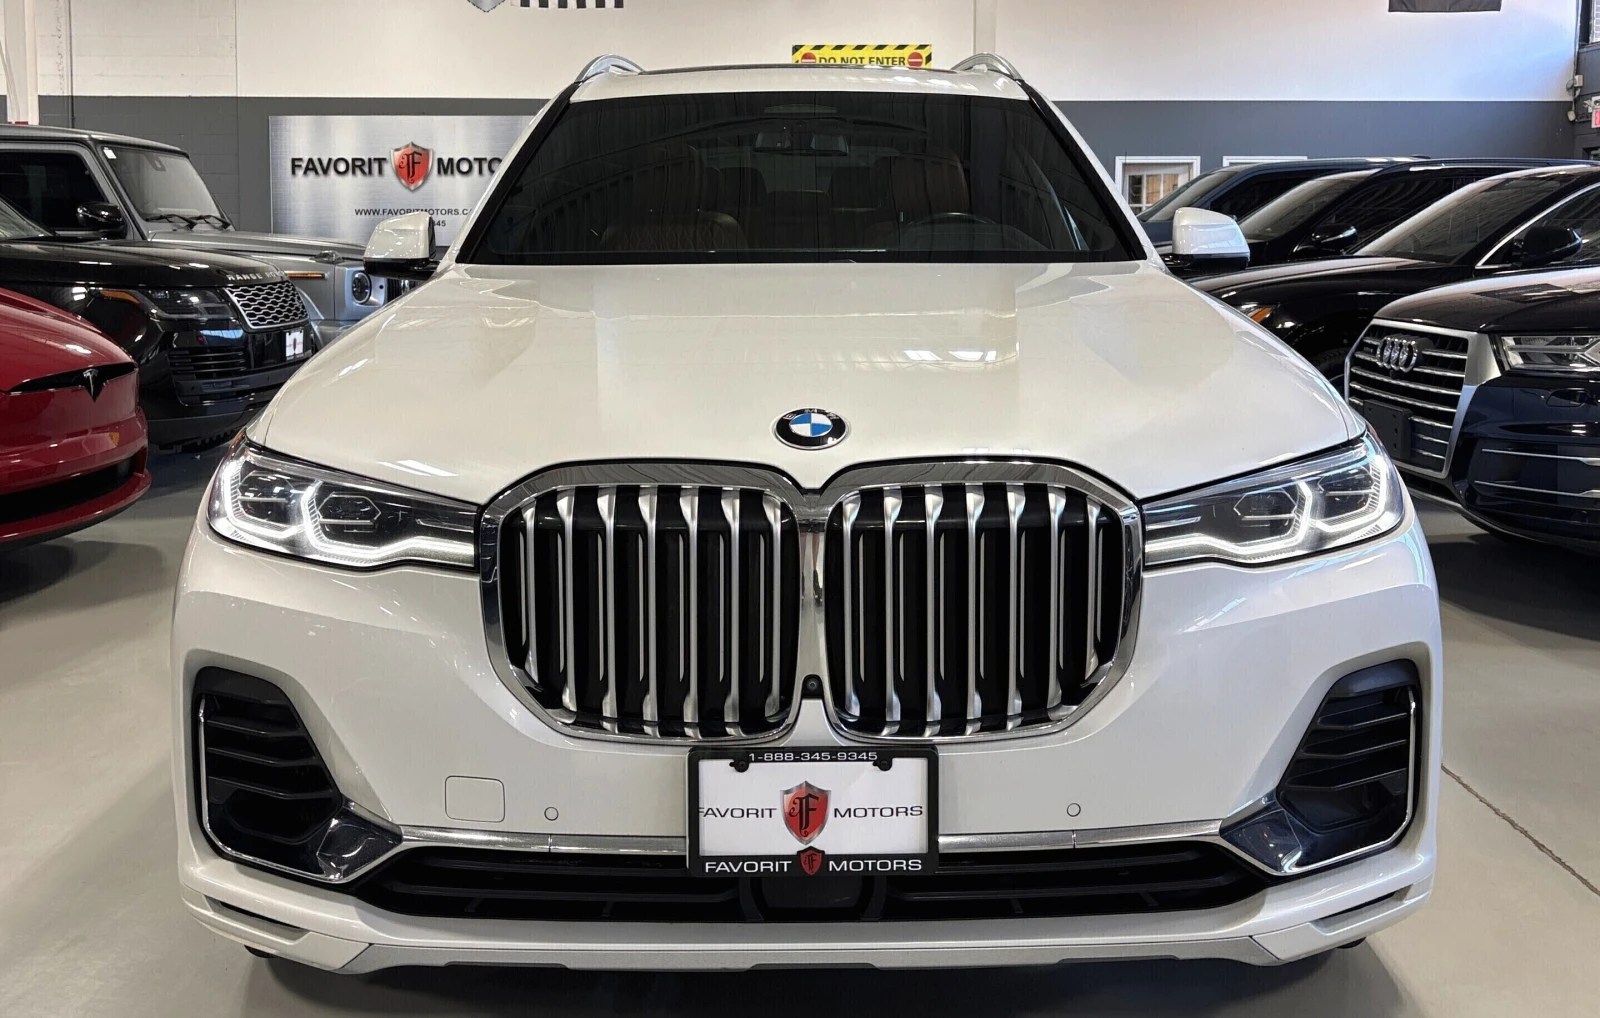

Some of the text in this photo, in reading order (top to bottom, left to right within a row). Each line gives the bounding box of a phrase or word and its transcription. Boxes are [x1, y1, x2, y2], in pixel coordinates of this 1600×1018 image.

[818, 56, 906, 66] DO NOT ENTER
[291, 157, 387, 176] FAVORIT
[436, 156, 503, 176] MOTO
[226, 273, 264, 281] RANGE
[748, 751, 878, 762] 1-888-345-9345
[833, 805, 924, 819] MOTORS
[704, 860, 793, 873] FAVORIT
[828, 859, 923, 872] MOTORS
